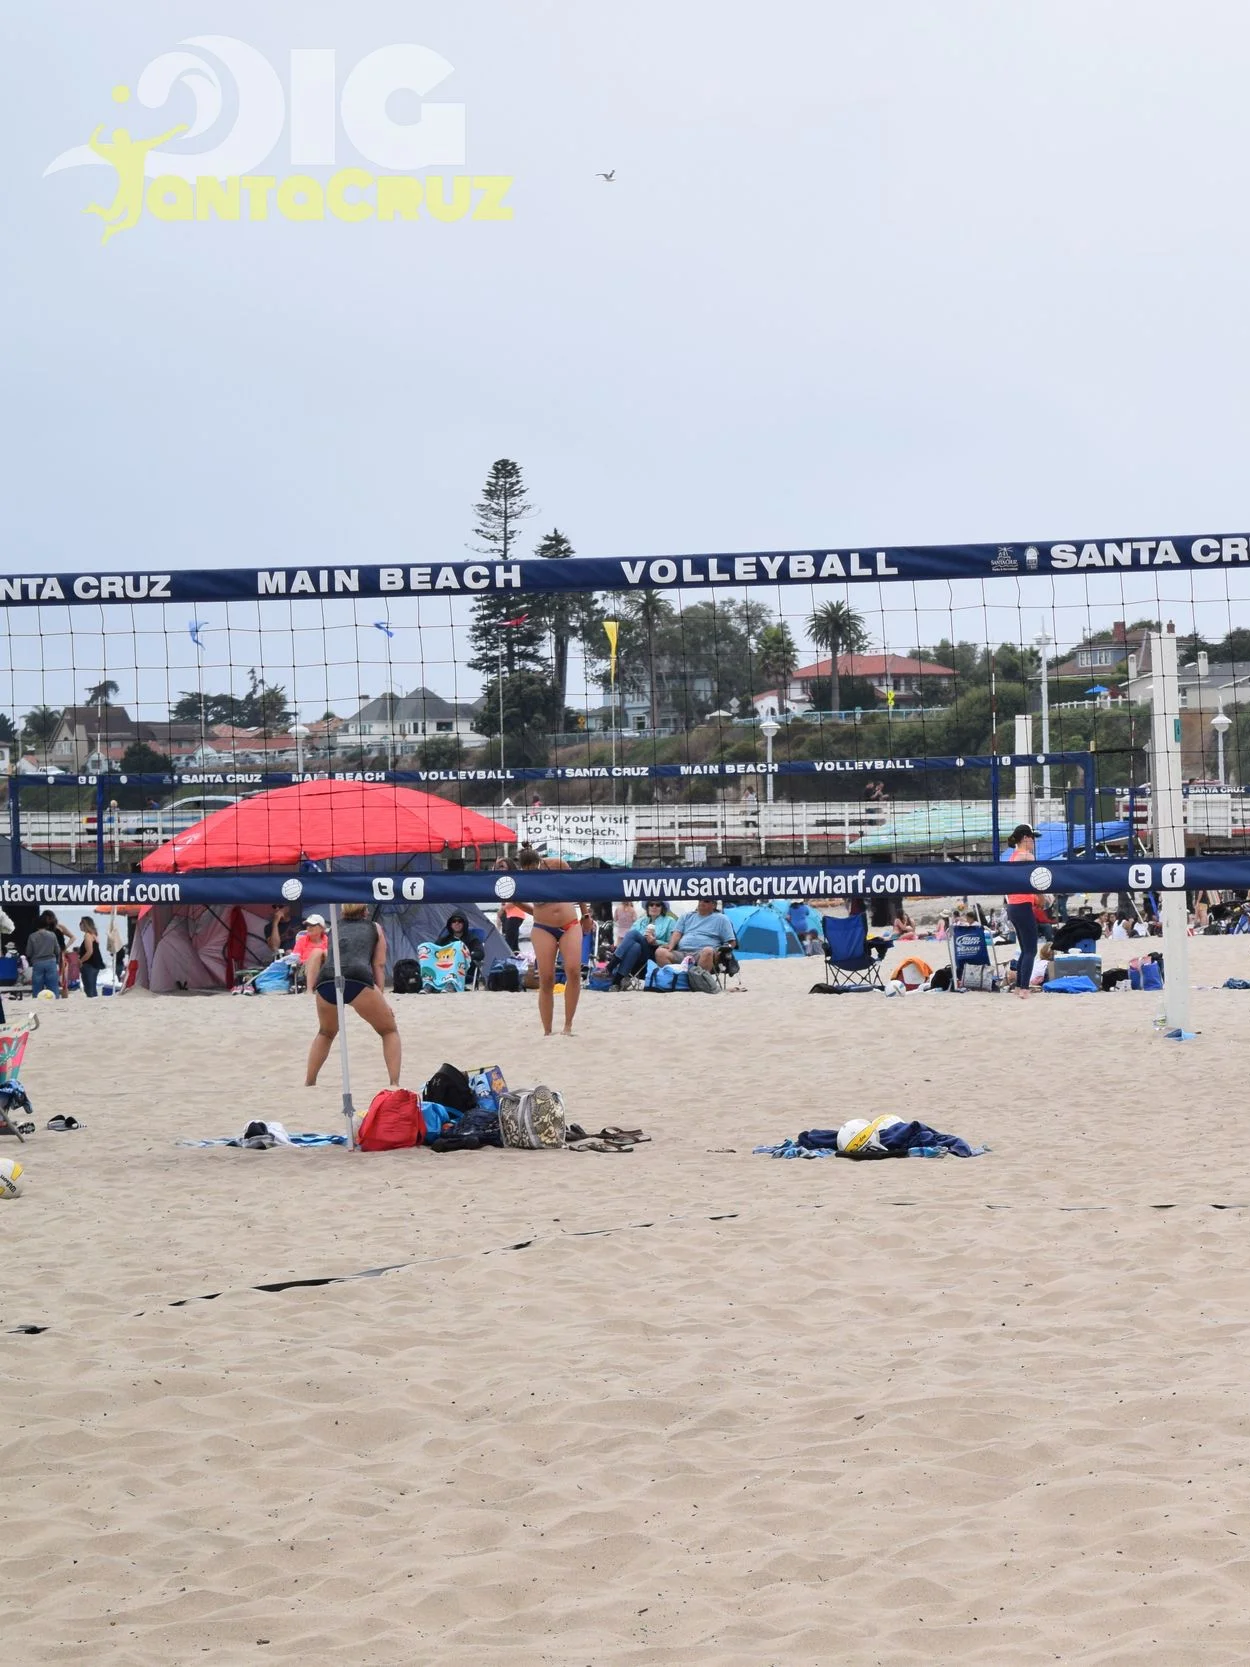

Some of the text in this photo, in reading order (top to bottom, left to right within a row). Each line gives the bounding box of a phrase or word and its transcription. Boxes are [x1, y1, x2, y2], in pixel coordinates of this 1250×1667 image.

[73, 575, 171, 598] CRUZ
[257, 568, 360, 595] MAIN
[380, 565, 522, 591] BEACH
[620, 552, 898, 584] VOLLEYBALL
[1050, 540, 1181, 569] SANTA
[181, 775, 223, 784] SANTA
[226, 774, 262, 783] CRUZ
[335, 772, 386, 781] BEACH
[418, 770, 514, 781] VOLLEYBALL
[565, 768, 608, 777] SANTA
[612, 766, 649, 776] CRUZ
[680, 765, 719, 775] MAIN
[725, 763, 779, 773] BEACH
[814, 759, 914, 771] VOLLEYBALL
[1188, 786, 1218, 794] SANTA
[522, 814, 629, 824] Enjoy your visit
[527, 826, 542, 834] to
[546, 824, 570, 834] this
[0, 879, 180, 902] tacruzwharf.com
[622, 869, 921, 898] www.santacruzwharf.com
